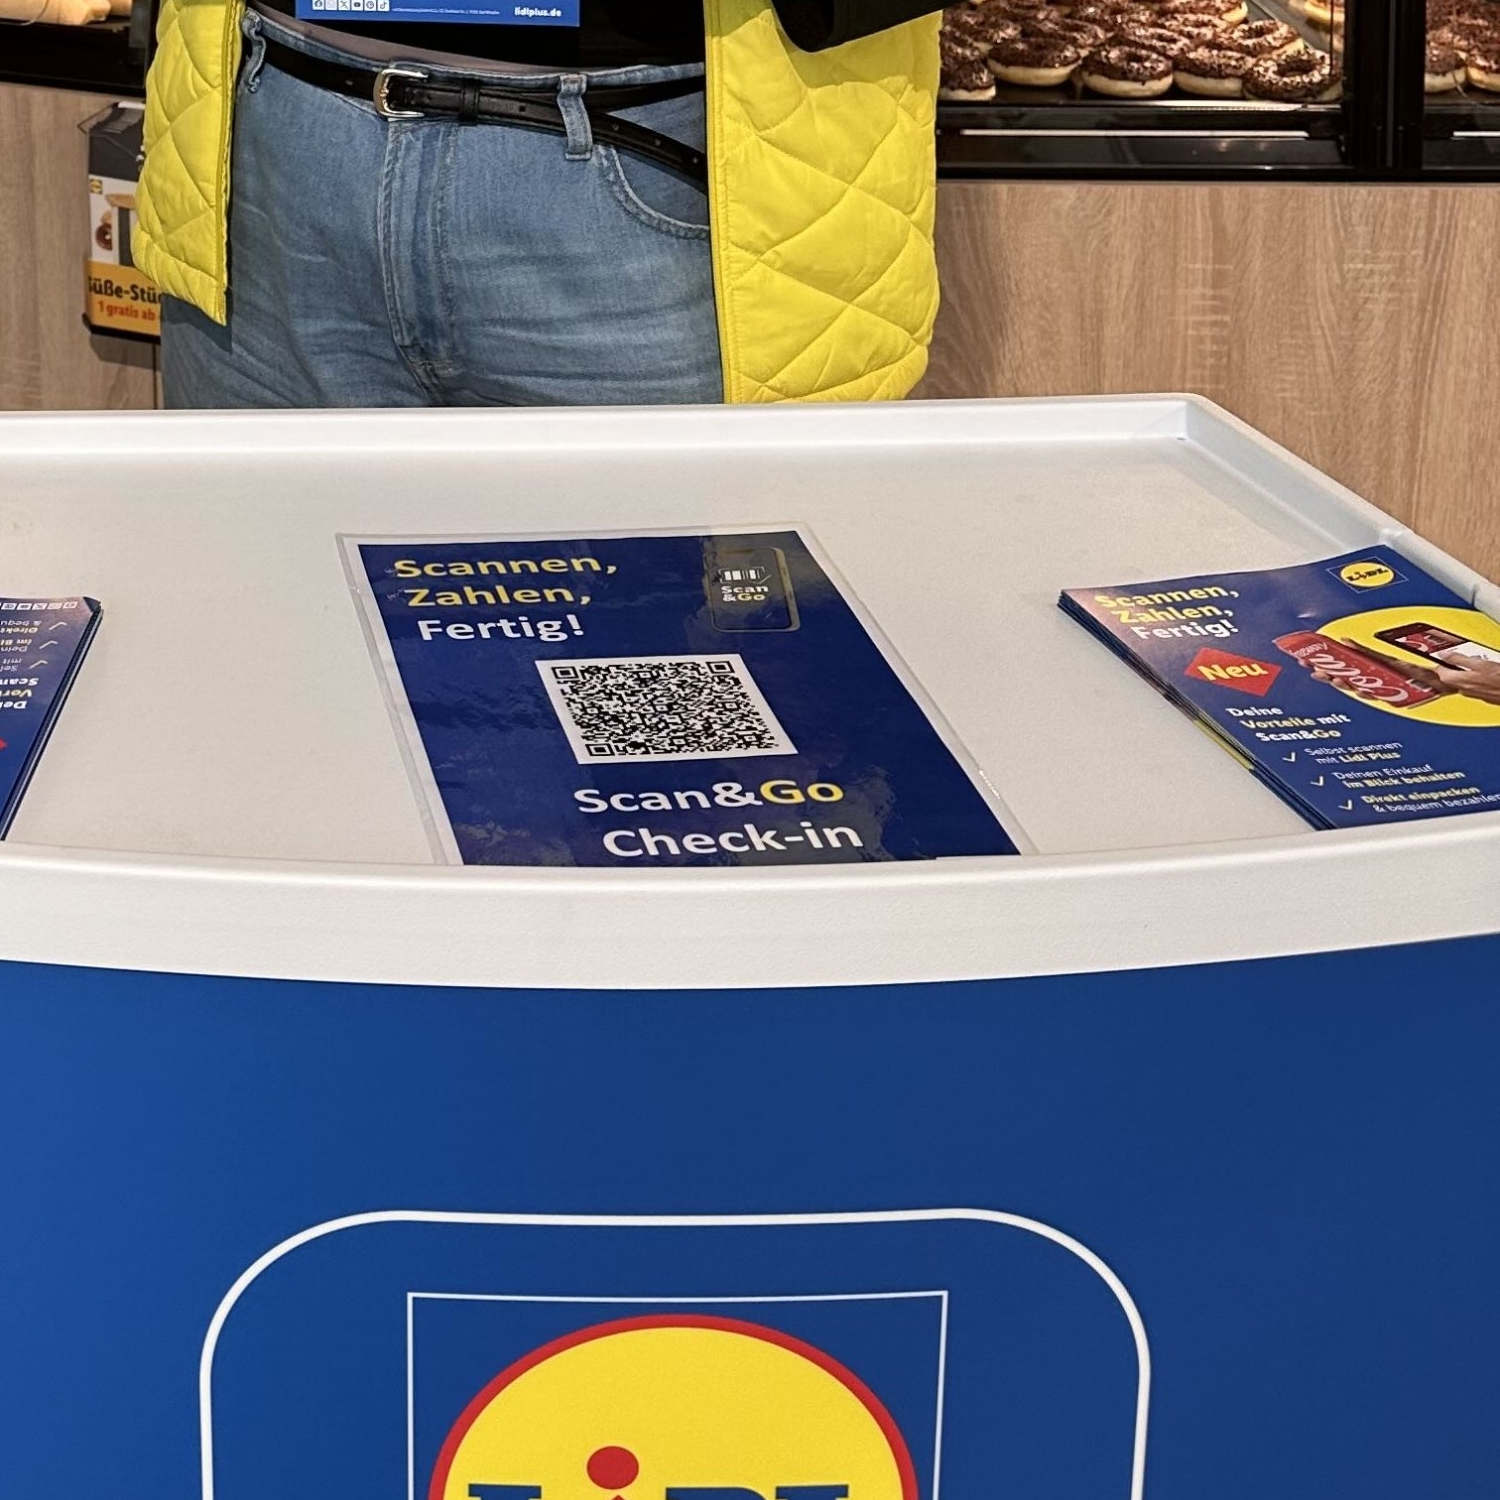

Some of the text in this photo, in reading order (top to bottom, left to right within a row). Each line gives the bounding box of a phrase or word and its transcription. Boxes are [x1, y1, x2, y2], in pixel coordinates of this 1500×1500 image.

[514, 6, 562, 17] lidlplus.de
[106, 304, 139, 319] gratis
[393, 552, 617, 579] Scannen,
[405, 583, 592, 607] Zahlen,
[721, 586, 769, 594] Scan
[723, 593, 765, 602] &Go
[1094, 585, 1239, 608] Scannen,
[1111, 604, 1234, 624] Zahlen,
[417, 614, 584, 642] Fertig!
[1130, 619, 1239, 641] Fertig!
[1197, 663, 1269, 681] Neu
[1226, 706, 1283, 718] Deine
[1240, 713, 1351, 730] Vorteile mit
[1255, 729, 1342, 742] Scan&Go
[1304, 741, 1403, 756] Selbst scannen
[1315, 751, 1401, 765] mit Lidl Plus
[1333, 764, 1433, 780] Deinen Einkauf
[1363, 776, 1401, 788] Blick
[1402, 770, 1466, 785] behalten
[573, 778, 845, 813] Scan&Go
[1361, 786, 1481, 804] Direkt einpacken
[1389, 800, 1443, 814] bequem
[602, 822, 863, 858] Check-in
